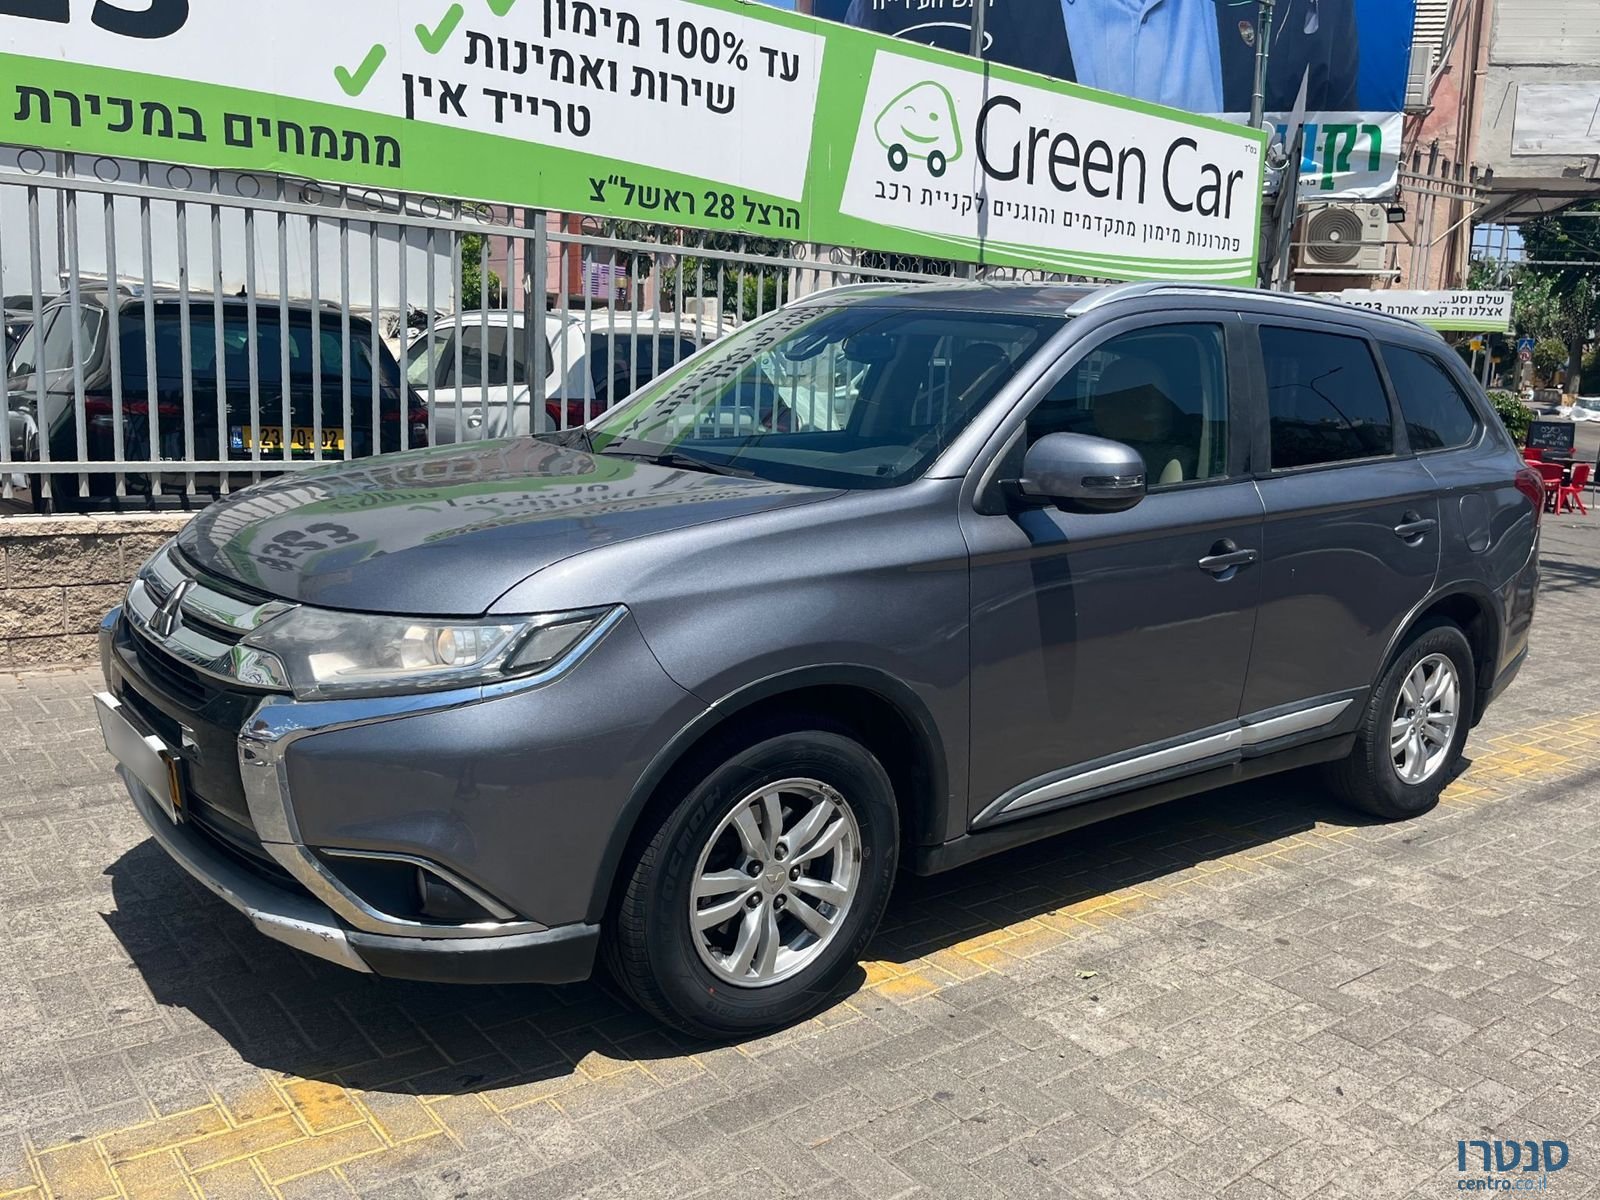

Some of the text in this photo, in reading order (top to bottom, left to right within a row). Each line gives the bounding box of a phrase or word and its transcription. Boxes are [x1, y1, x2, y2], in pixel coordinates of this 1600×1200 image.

[544, 0, 800, 82] עד 100% מימון
[464, 30, 735, 115] שירות ואמינות
[402, 73, 591, 137] טרייד אין
[14, 85, 401, 168] מתמחים במכירת
[975, 95, 1146, 204] Green
[1162, 137, 1243, 219] Car
[704, 192, 734, 220] 28
[743, 196, 800, 230] הרצל
[874, 180, 1241, 253] פתרונות מימון מתקדמים והוגנים לקניית רכב
[1387, 305, 1418, 315] אחרת
[1422, 305, 1447, 317] קצת
[1451, 306, 1464, 316] זה
[1468, 305, 1503, 317] אצלנו
[1476, 294, 1504, 306] שלם
